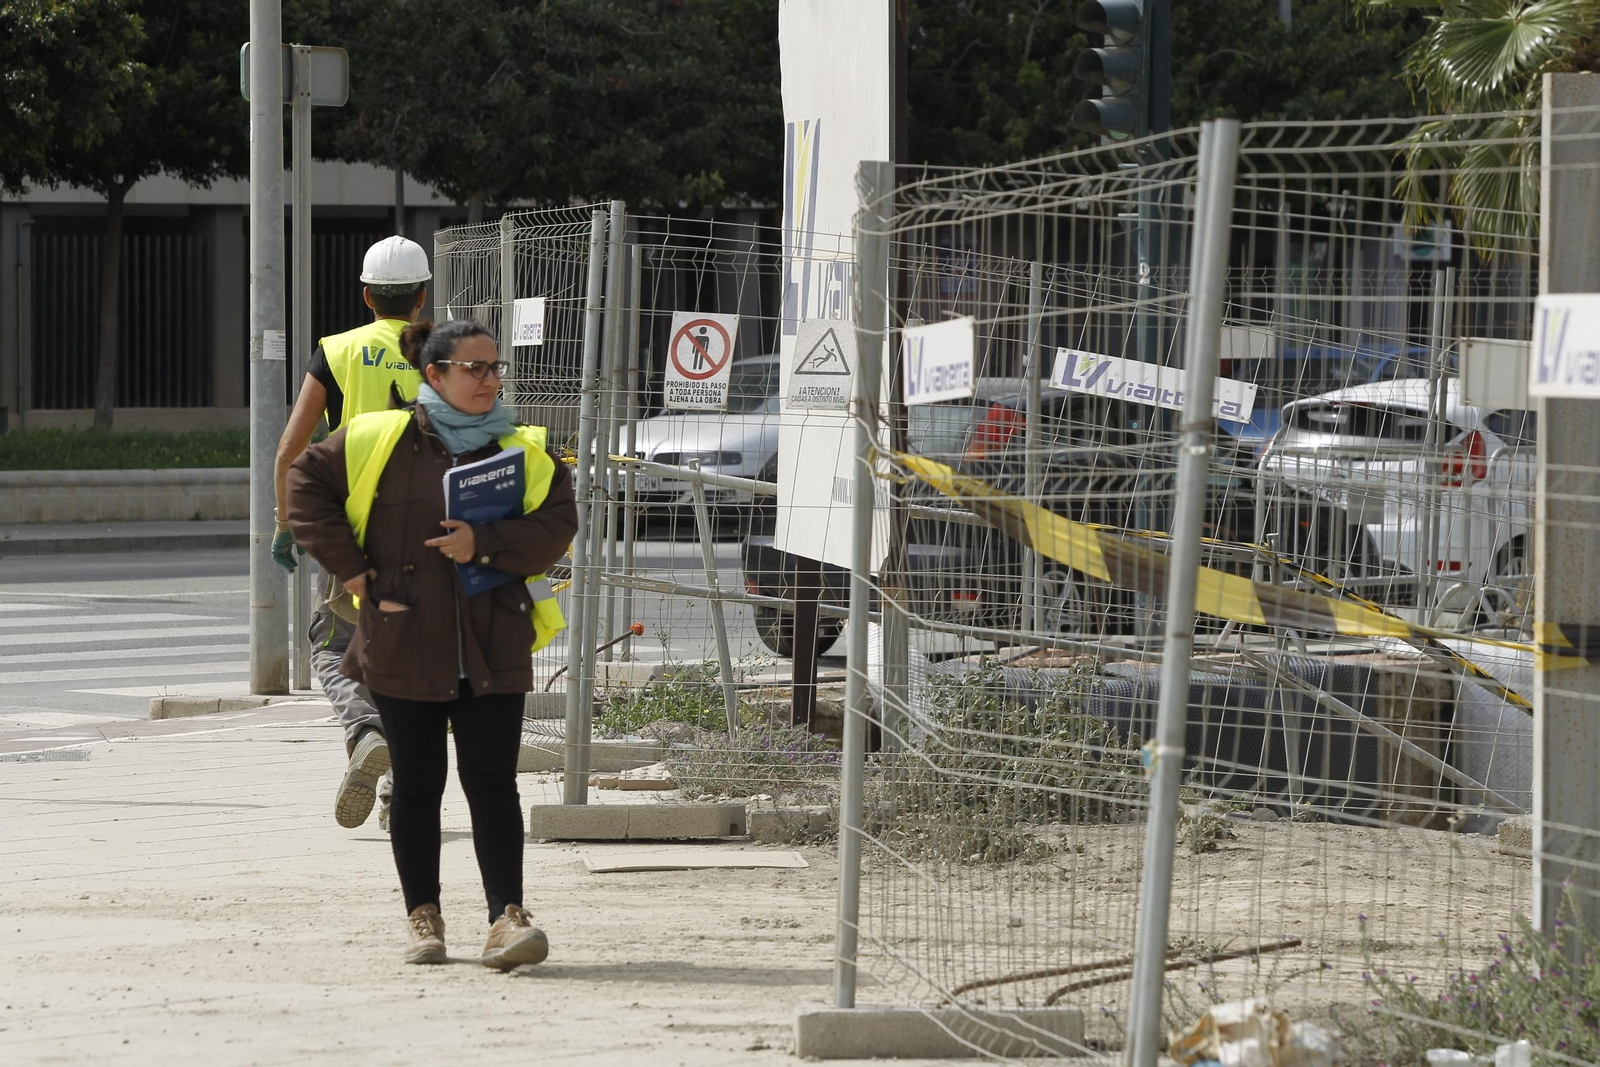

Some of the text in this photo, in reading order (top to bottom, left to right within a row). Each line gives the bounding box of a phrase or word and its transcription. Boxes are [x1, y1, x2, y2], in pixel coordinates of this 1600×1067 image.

[666, 380, 700, 389] PROHIBIDO
[710, 382, 727, 390] PASO
[675, 388, 692, 396] TODA
[692, 389, 722, 397] PERSONA
[669, 395, 689, 403] AJENA
[695, 396, 703, 404] LA
